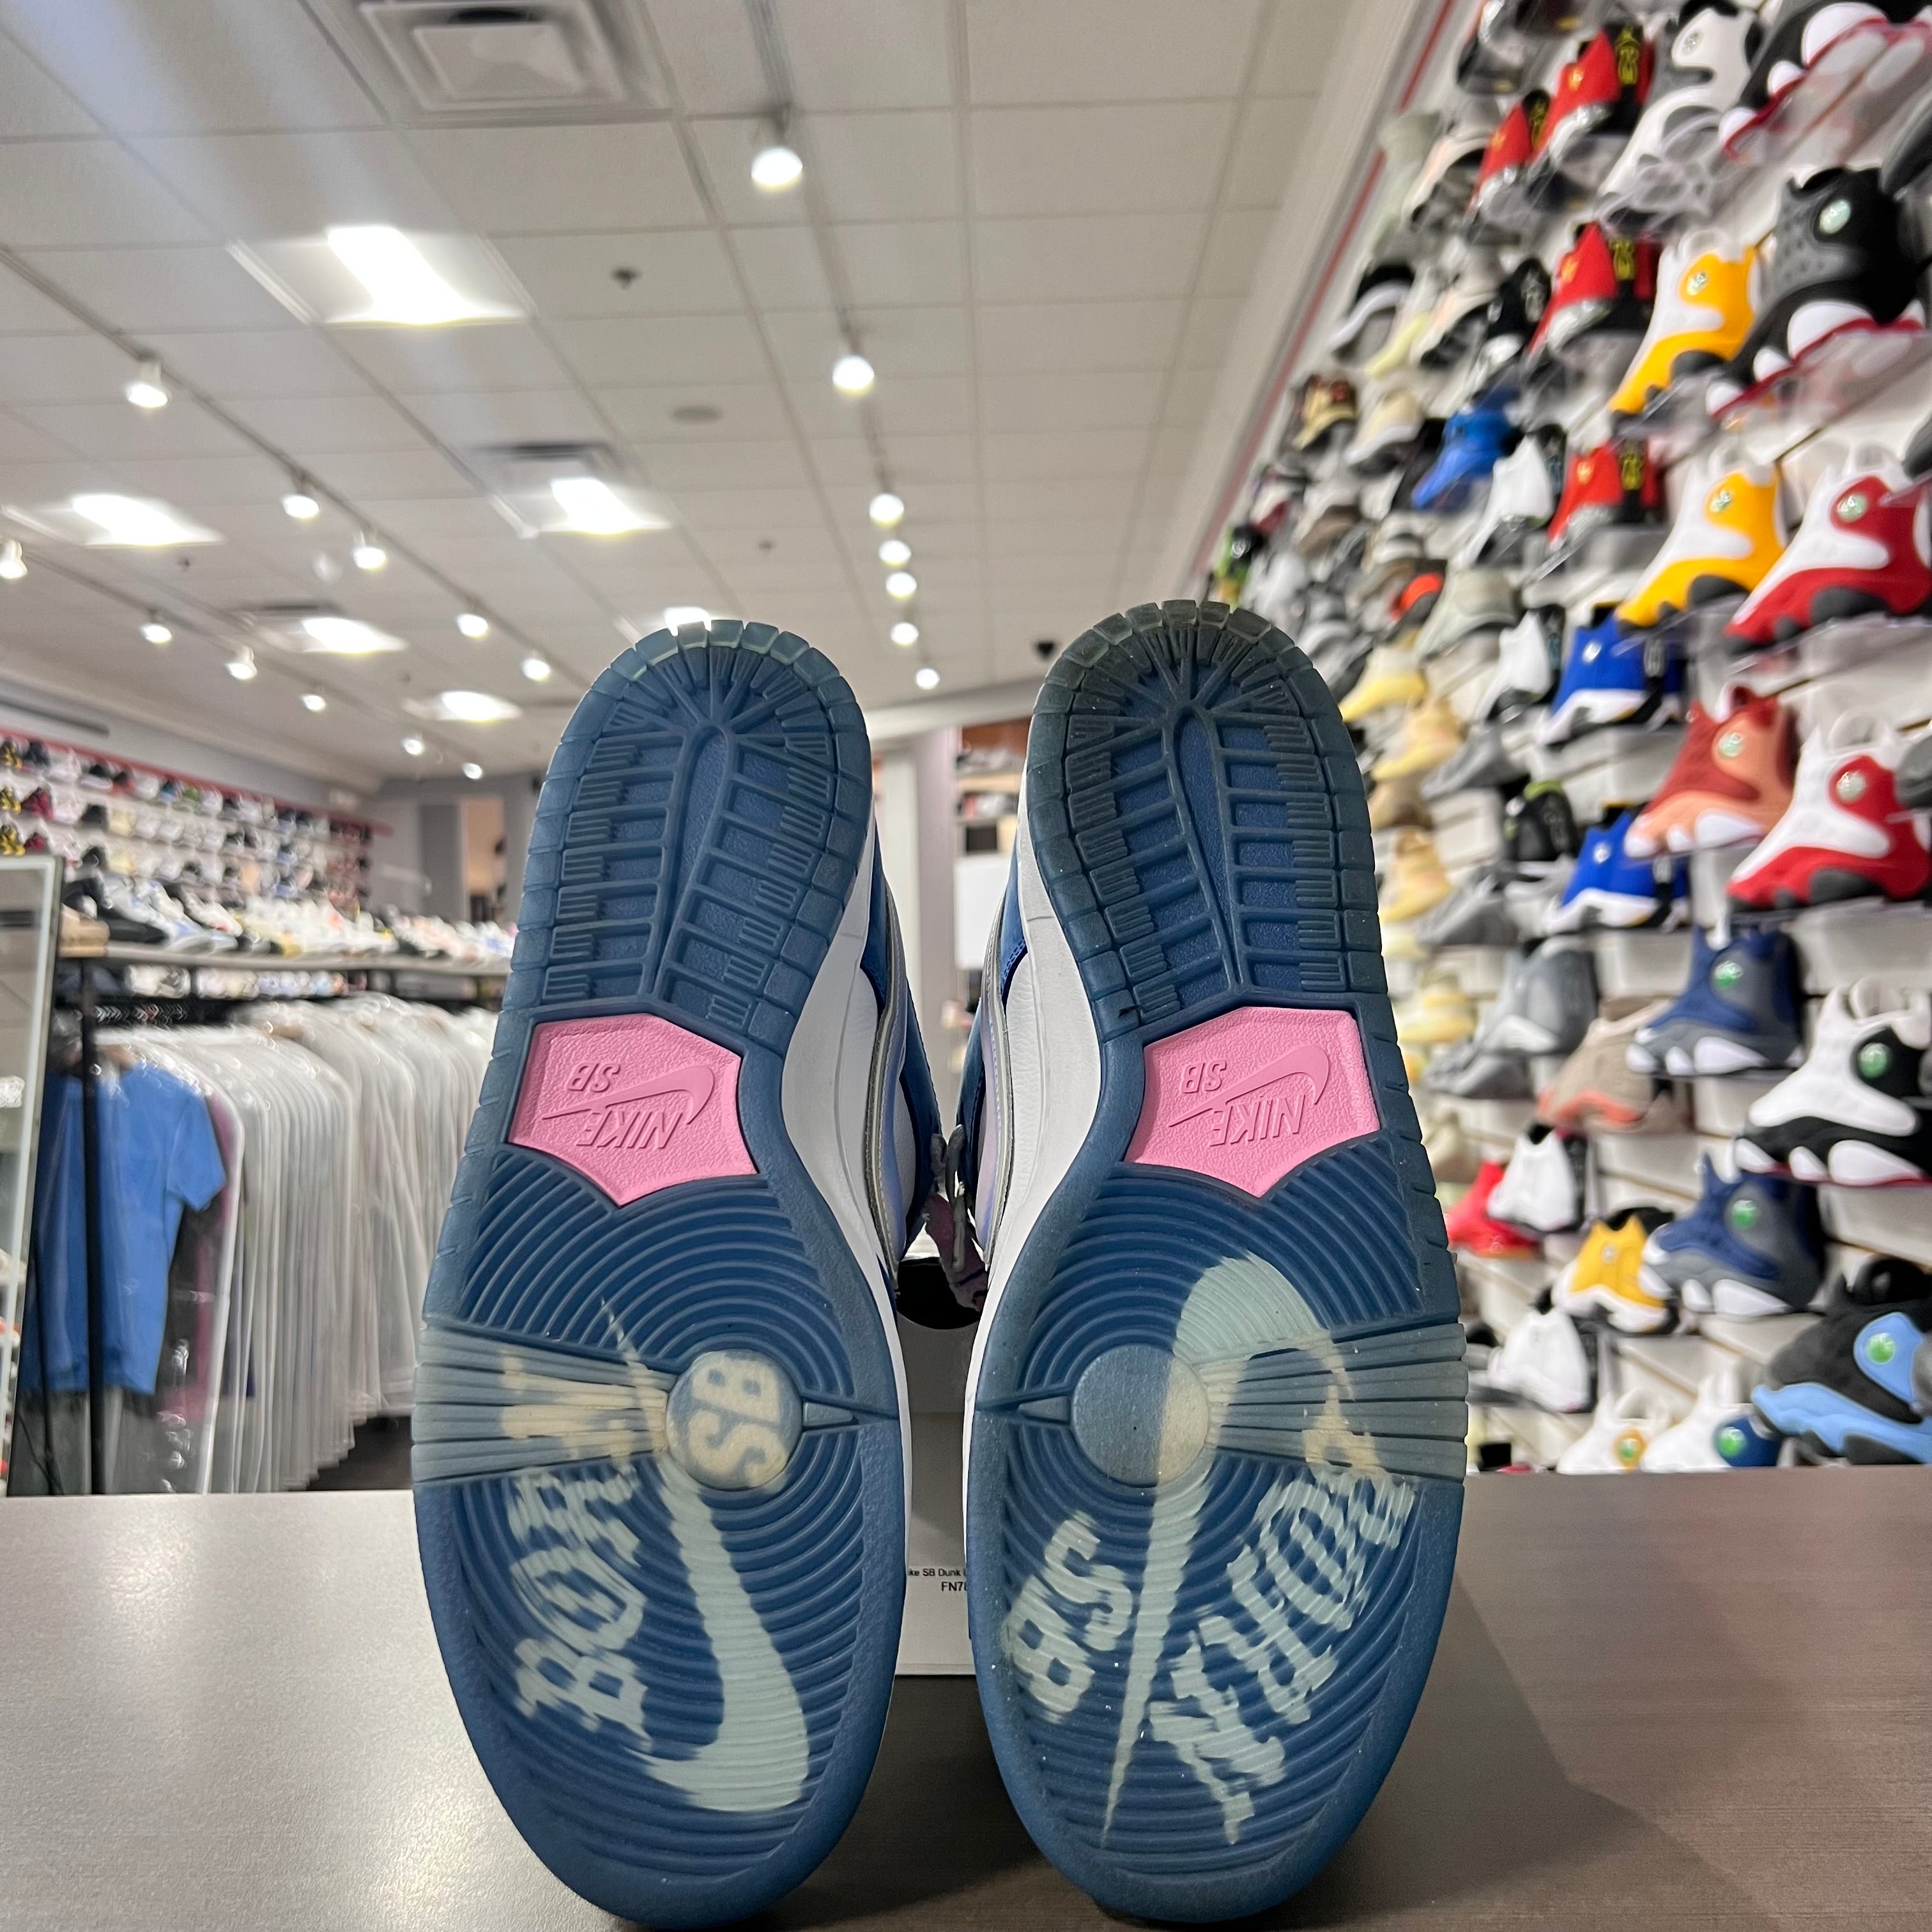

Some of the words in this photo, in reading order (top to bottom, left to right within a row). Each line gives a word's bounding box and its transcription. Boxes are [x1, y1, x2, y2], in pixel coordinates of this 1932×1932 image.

[566, 1062, 621, 1093] SB
[1181, 1059, 1227, 1094] SB
[576, 1109, 683, 1149] NIKE
[1209, 1093, 1306, 1147] NIKE
[687, 1349, 790, 1489] SB
[500, 1349, 654, 1754] BORN
[923, 1568, 935, 1577] SB
[939, 1568, 962, 1577] Dunk
[1003, 1510, 1132, 1723] SB
